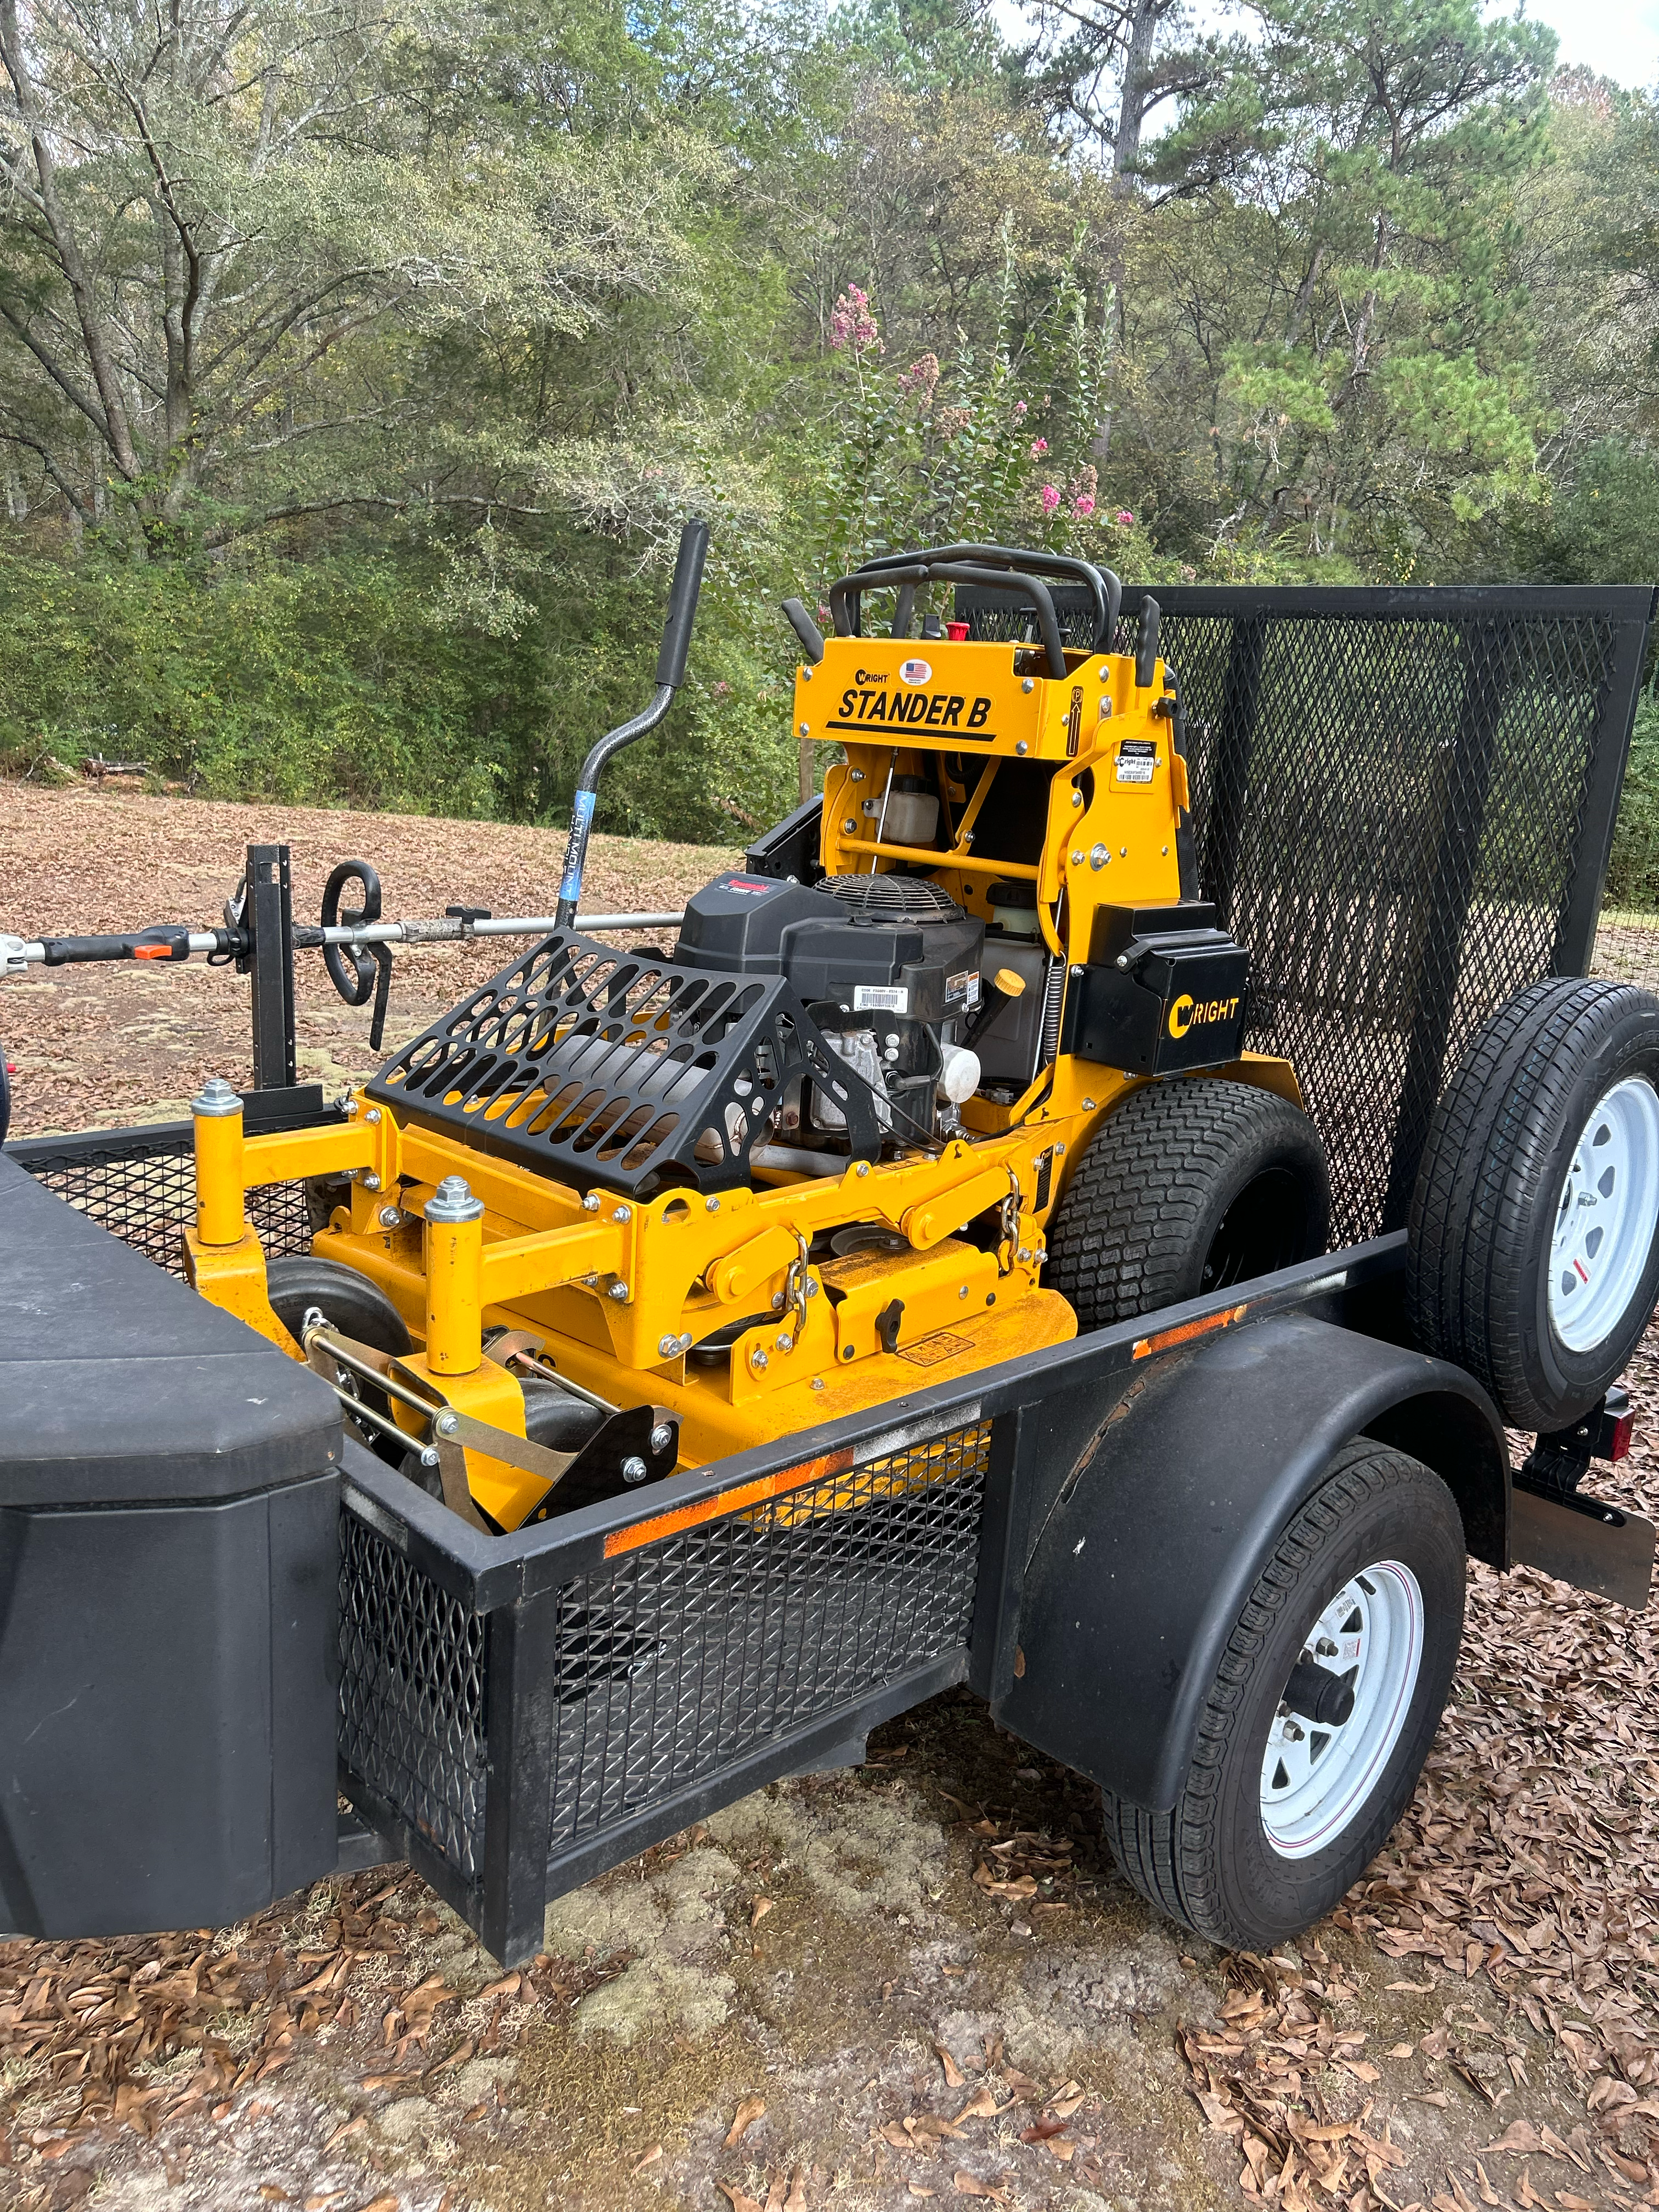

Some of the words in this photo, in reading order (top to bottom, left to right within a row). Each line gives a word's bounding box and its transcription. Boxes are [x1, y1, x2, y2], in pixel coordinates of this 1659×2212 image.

[855, 669, 888, 685] WRIGHT
[838, 689, 965, 726] STANDER
[966, 697, 991, 727] B
[573, 795, 588, 837] MULTI
[566, 842, 580, 896] MOUNT
[1169, 994, 1239, 1039] WRIGHT
